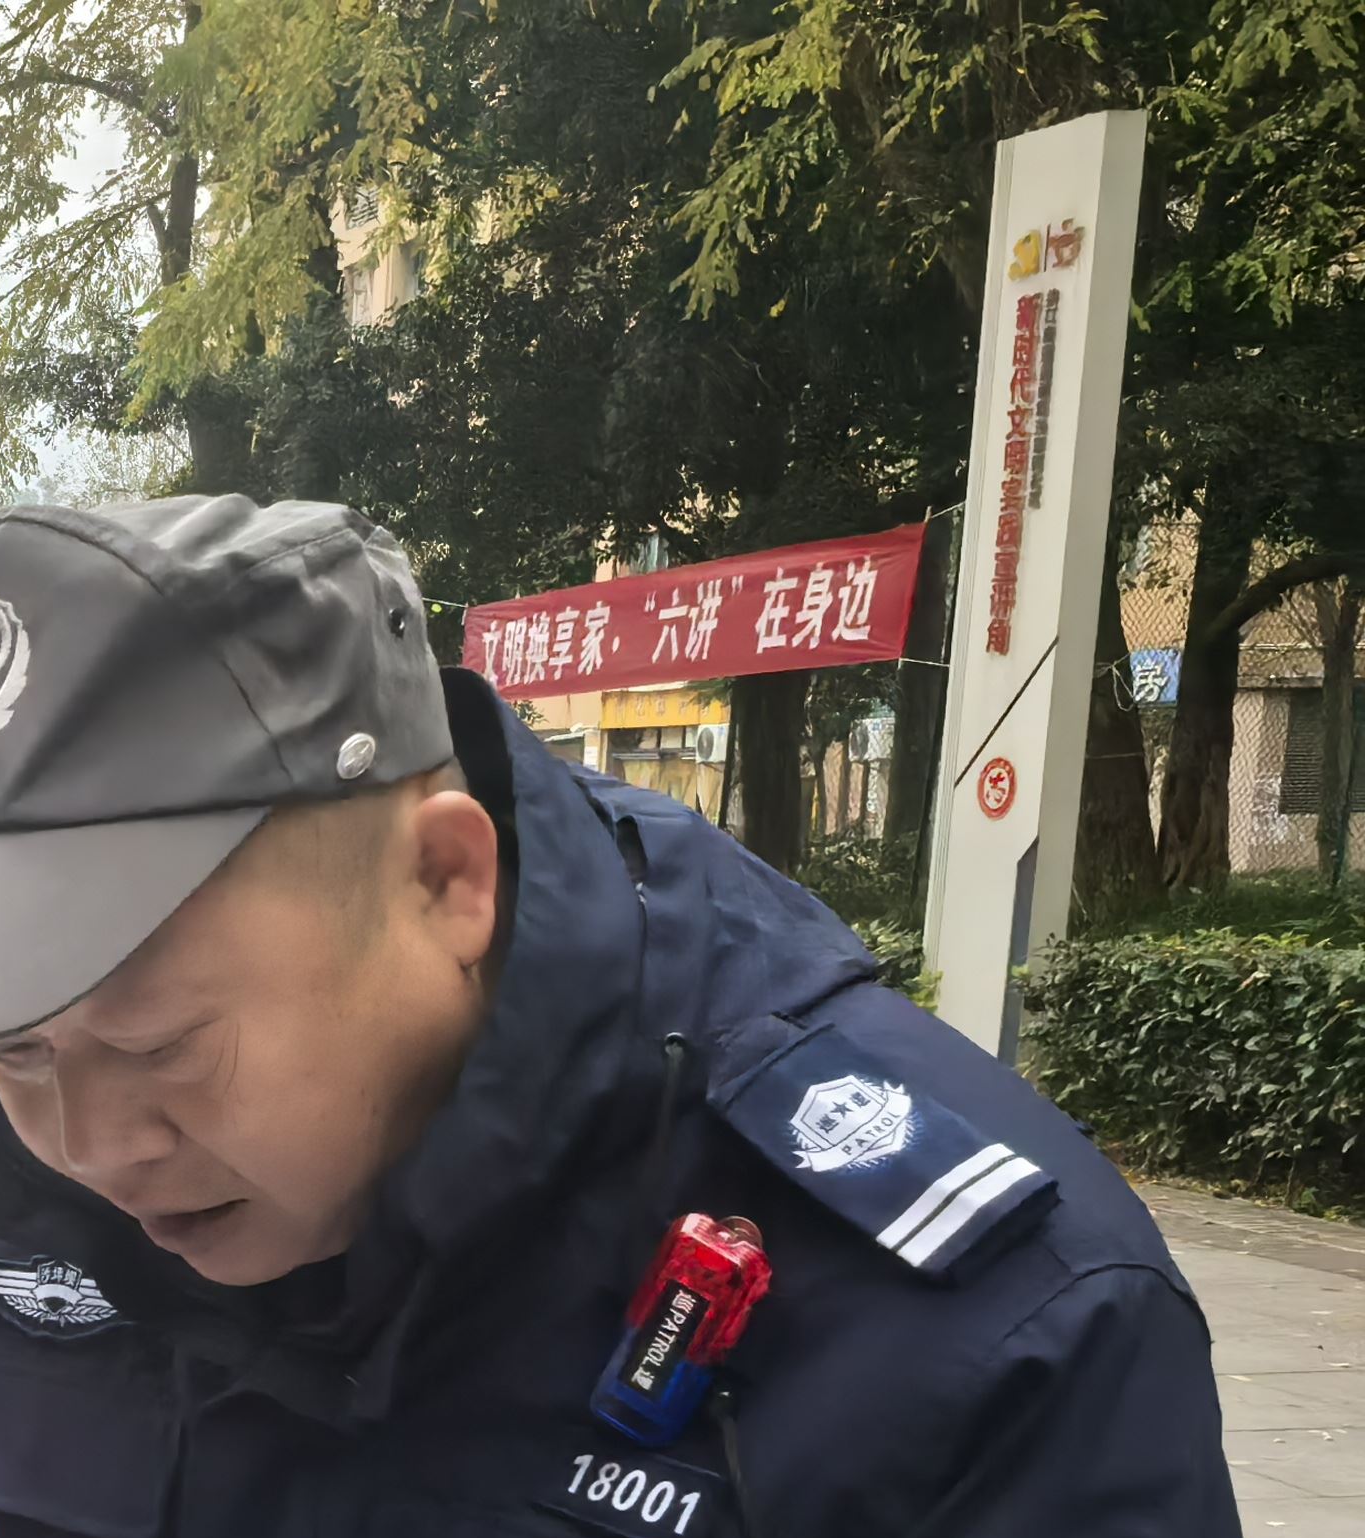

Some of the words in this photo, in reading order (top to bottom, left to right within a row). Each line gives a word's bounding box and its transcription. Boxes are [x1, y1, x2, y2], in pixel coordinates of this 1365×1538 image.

[841, 1111, 901, 1155] PATROL
[641, 1308, 687, 1367] PATROL
[565, 1454, 702, 1536] 18001
